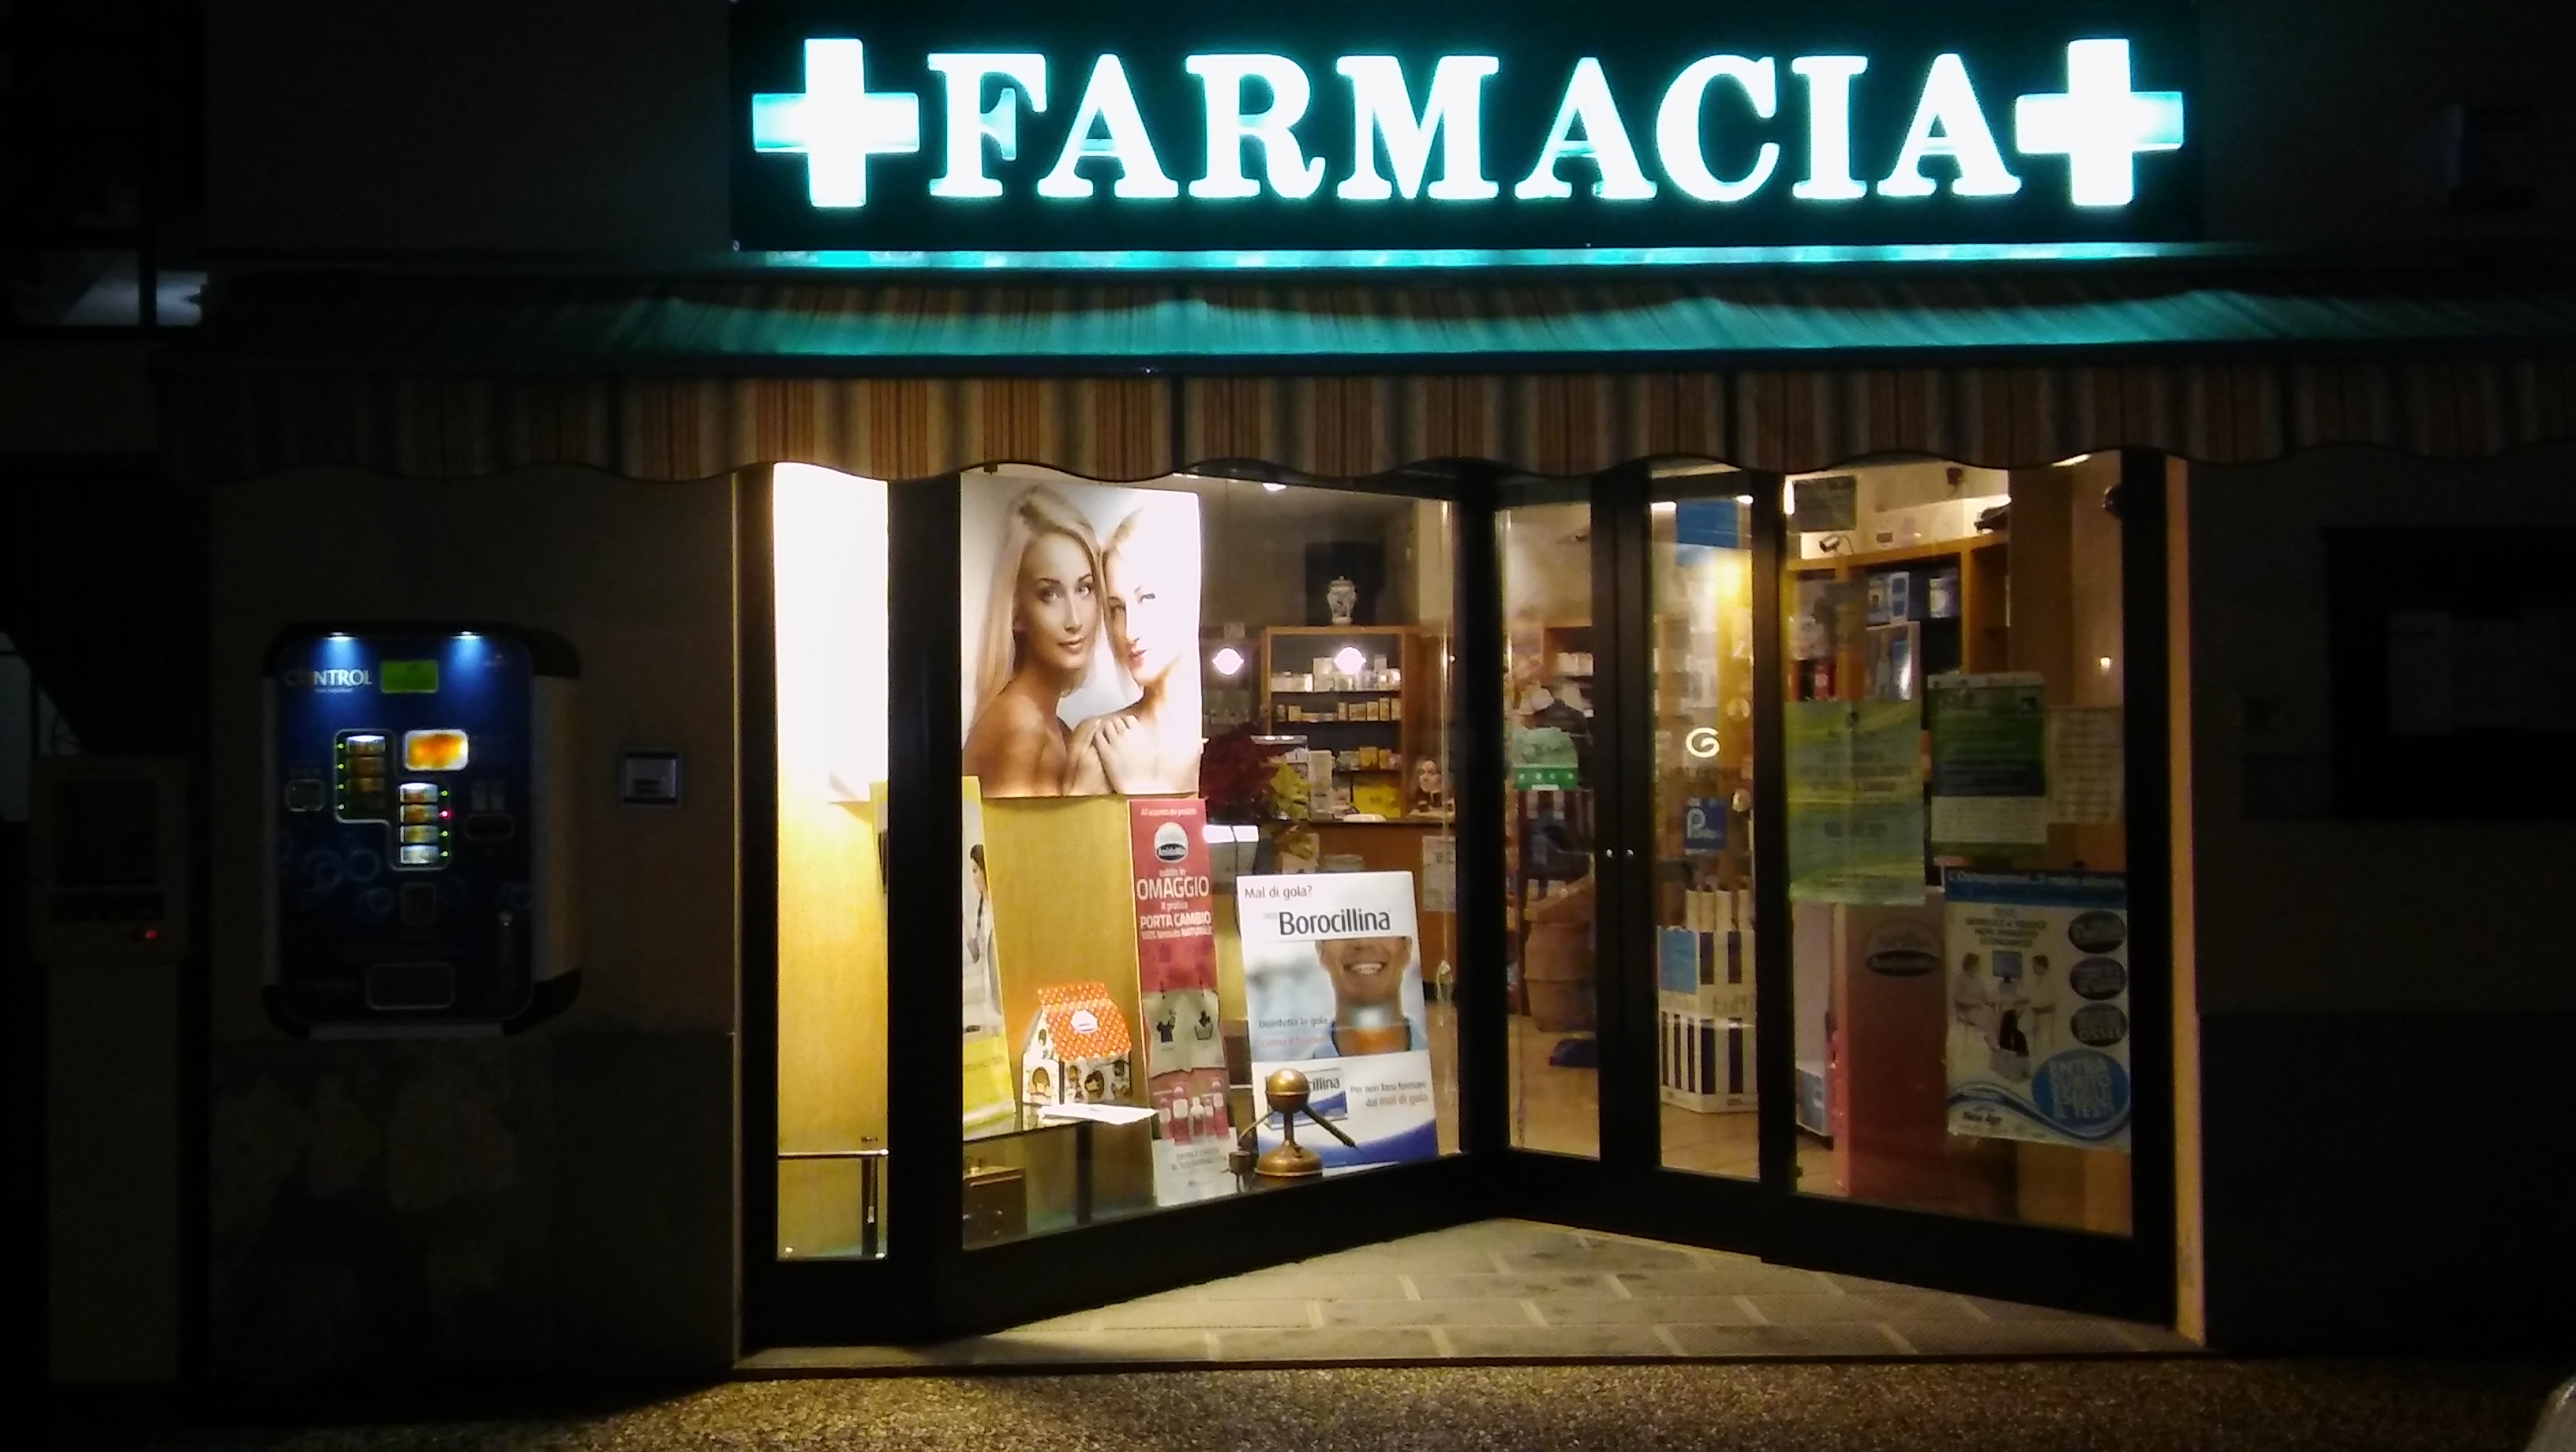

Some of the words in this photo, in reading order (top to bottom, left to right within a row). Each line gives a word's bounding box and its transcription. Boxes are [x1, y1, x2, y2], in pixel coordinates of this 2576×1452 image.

[927, 53, 2022, 203] FARMACIA
[1136, 876, 1210, 900] OMAGGIO
[1245, 886, 1266, 900] Mal
[1269, 886, 1280, 897] di
[1283, 885, 1312, 900] gola?
[1140, 914, 1174, 930] PORTA
[1174, 911, 1211, 927] CAMBIO
[1278, 908, 1391, 936] Borocillina
